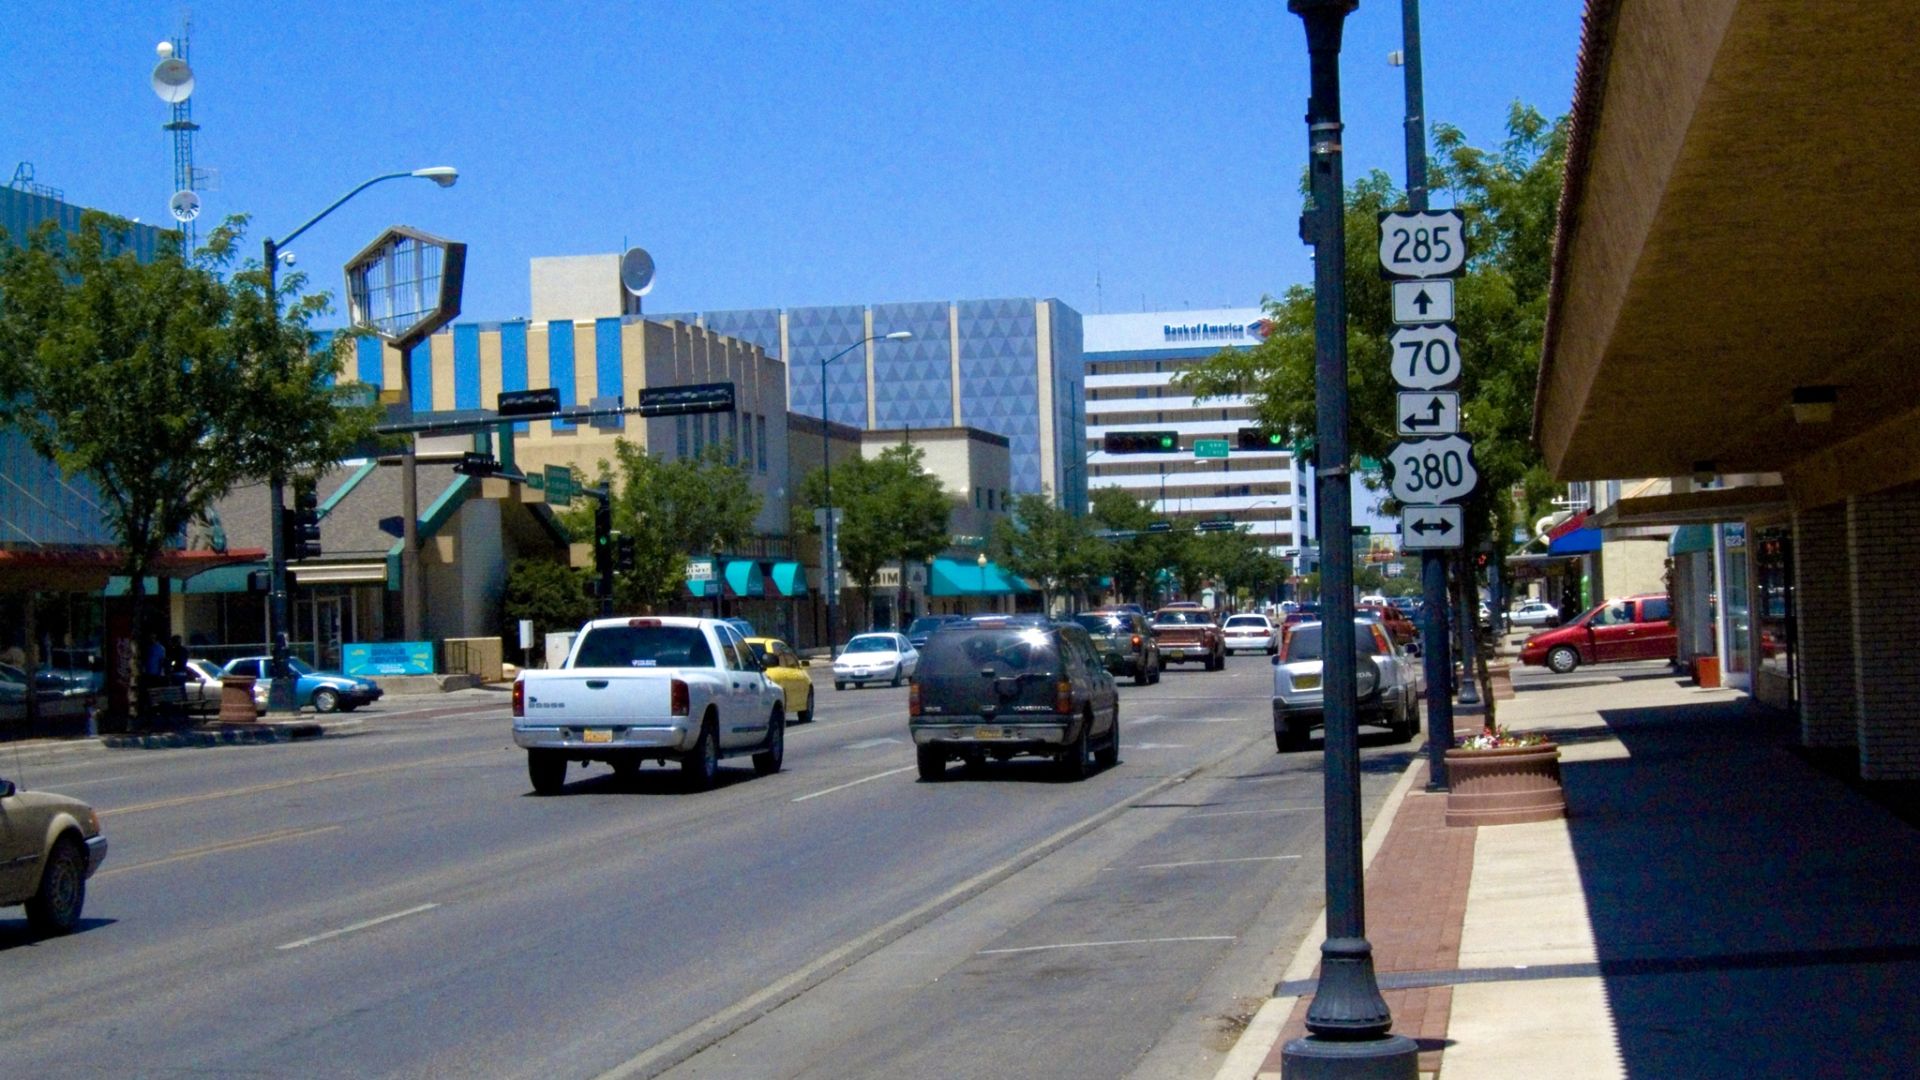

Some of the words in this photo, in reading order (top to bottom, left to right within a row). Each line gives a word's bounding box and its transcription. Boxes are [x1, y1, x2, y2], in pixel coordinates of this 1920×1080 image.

[1393, 226, 1451, 263] 285
[1164, 324, 1189, 335] Bank
[1190, 323, 1201, 334] of
[1202, 322, 1244, 334] America
[1400, 339, 1450, 377] 70
[1404, 450, 1463, 492] 380
